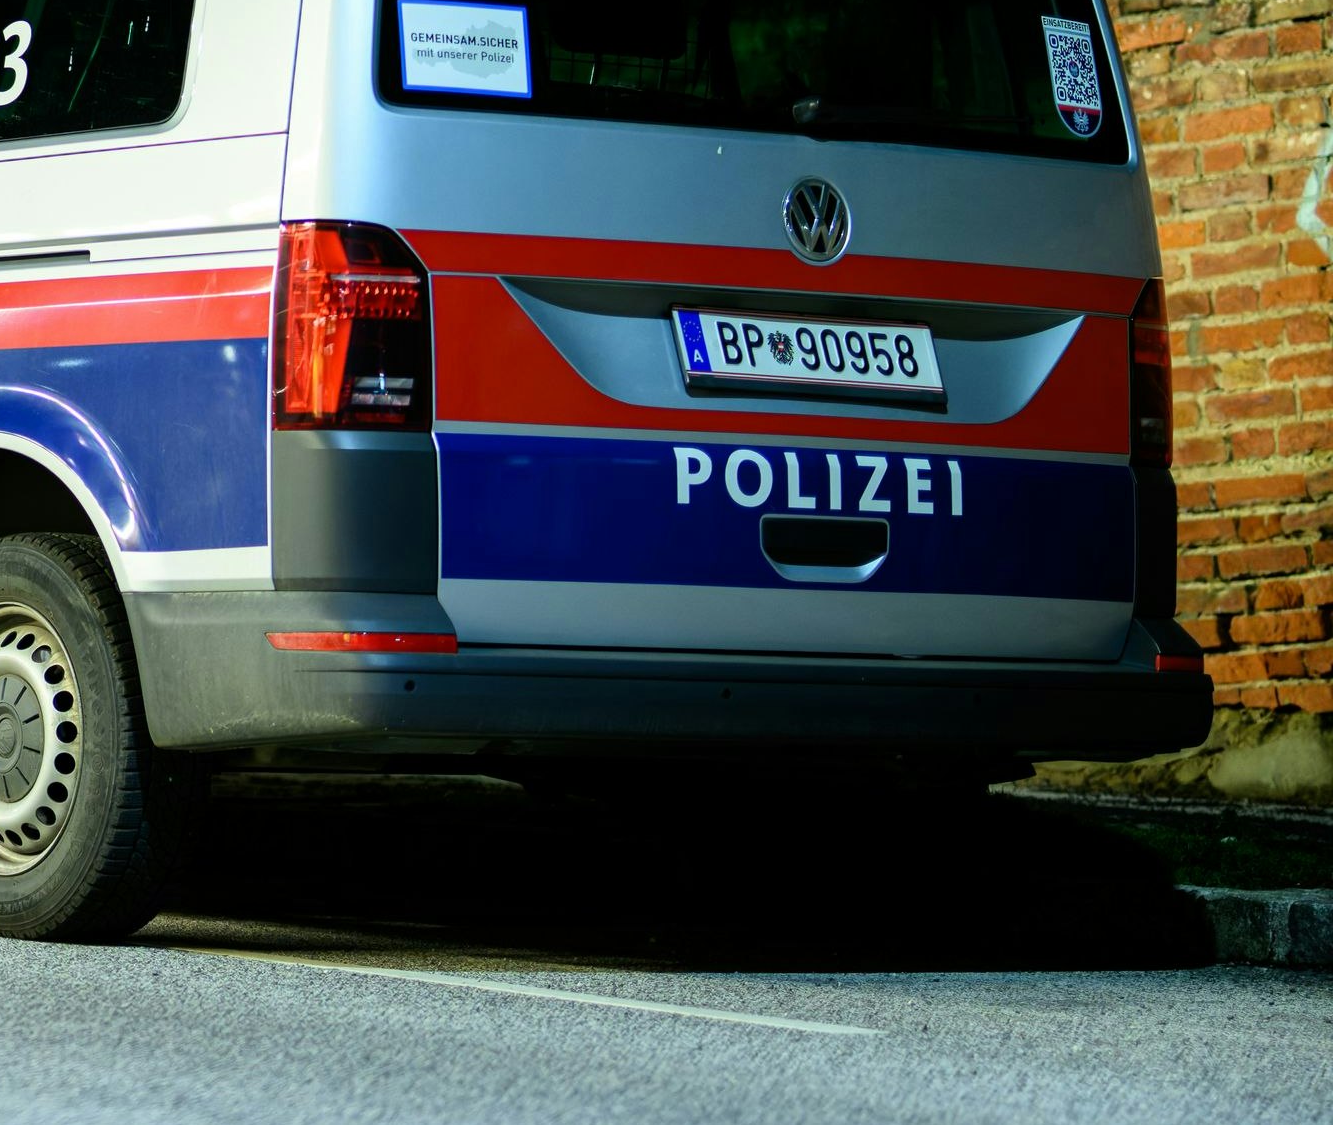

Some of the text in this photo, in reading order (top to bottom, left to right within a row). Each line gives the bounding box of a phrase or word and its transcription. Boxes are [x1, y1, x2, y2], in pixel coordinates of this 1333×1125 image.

[410, 32, 519, 50] GEMEINSAM.SICHER
[416, 47, 515, 64] mit unserer Polizei
[693, 348, 704, 364] A
[716, 321, 919, 378] BP 90958
[673, 446, 963, 516] POLIZEI
